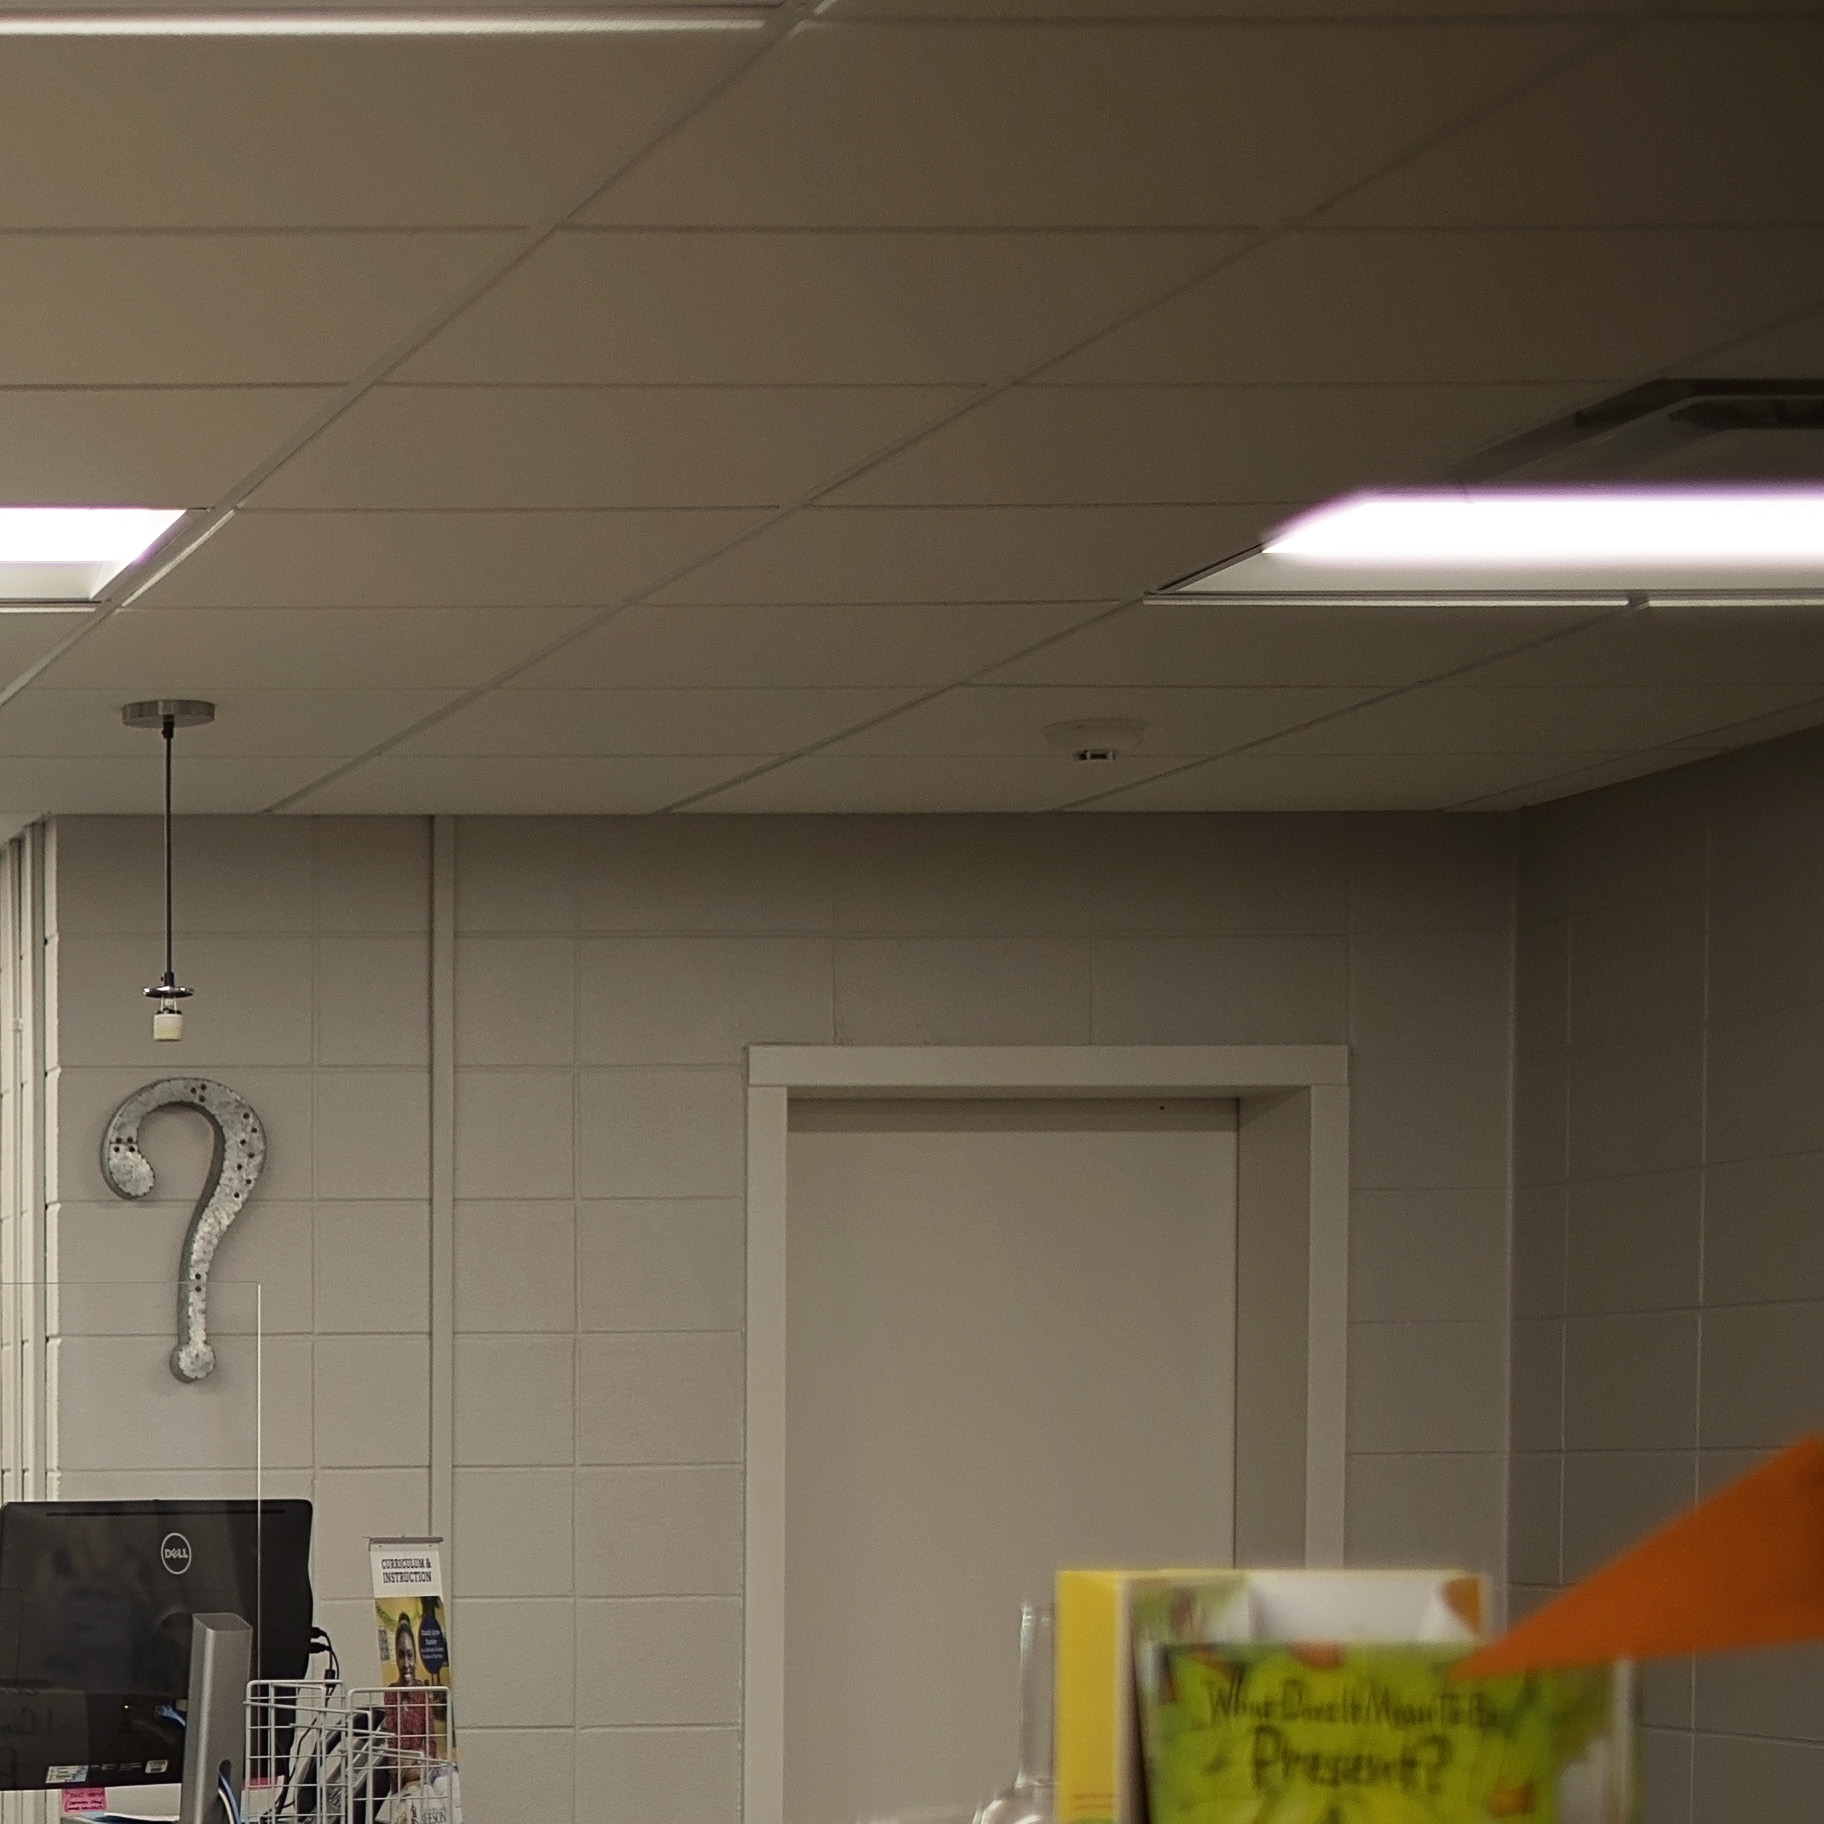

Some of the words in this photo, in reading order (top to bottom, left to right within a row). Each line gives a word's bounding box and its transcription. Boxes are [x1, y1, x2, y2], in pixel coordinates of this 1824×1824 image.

[164, 1548, 189, 1559] DELL
[380, 1558, 425, 1570] CURRICULUM
[382, 1571, 433, 1584] INSTRUCTION
[1249, 1723, 1453, 1794] Present?
